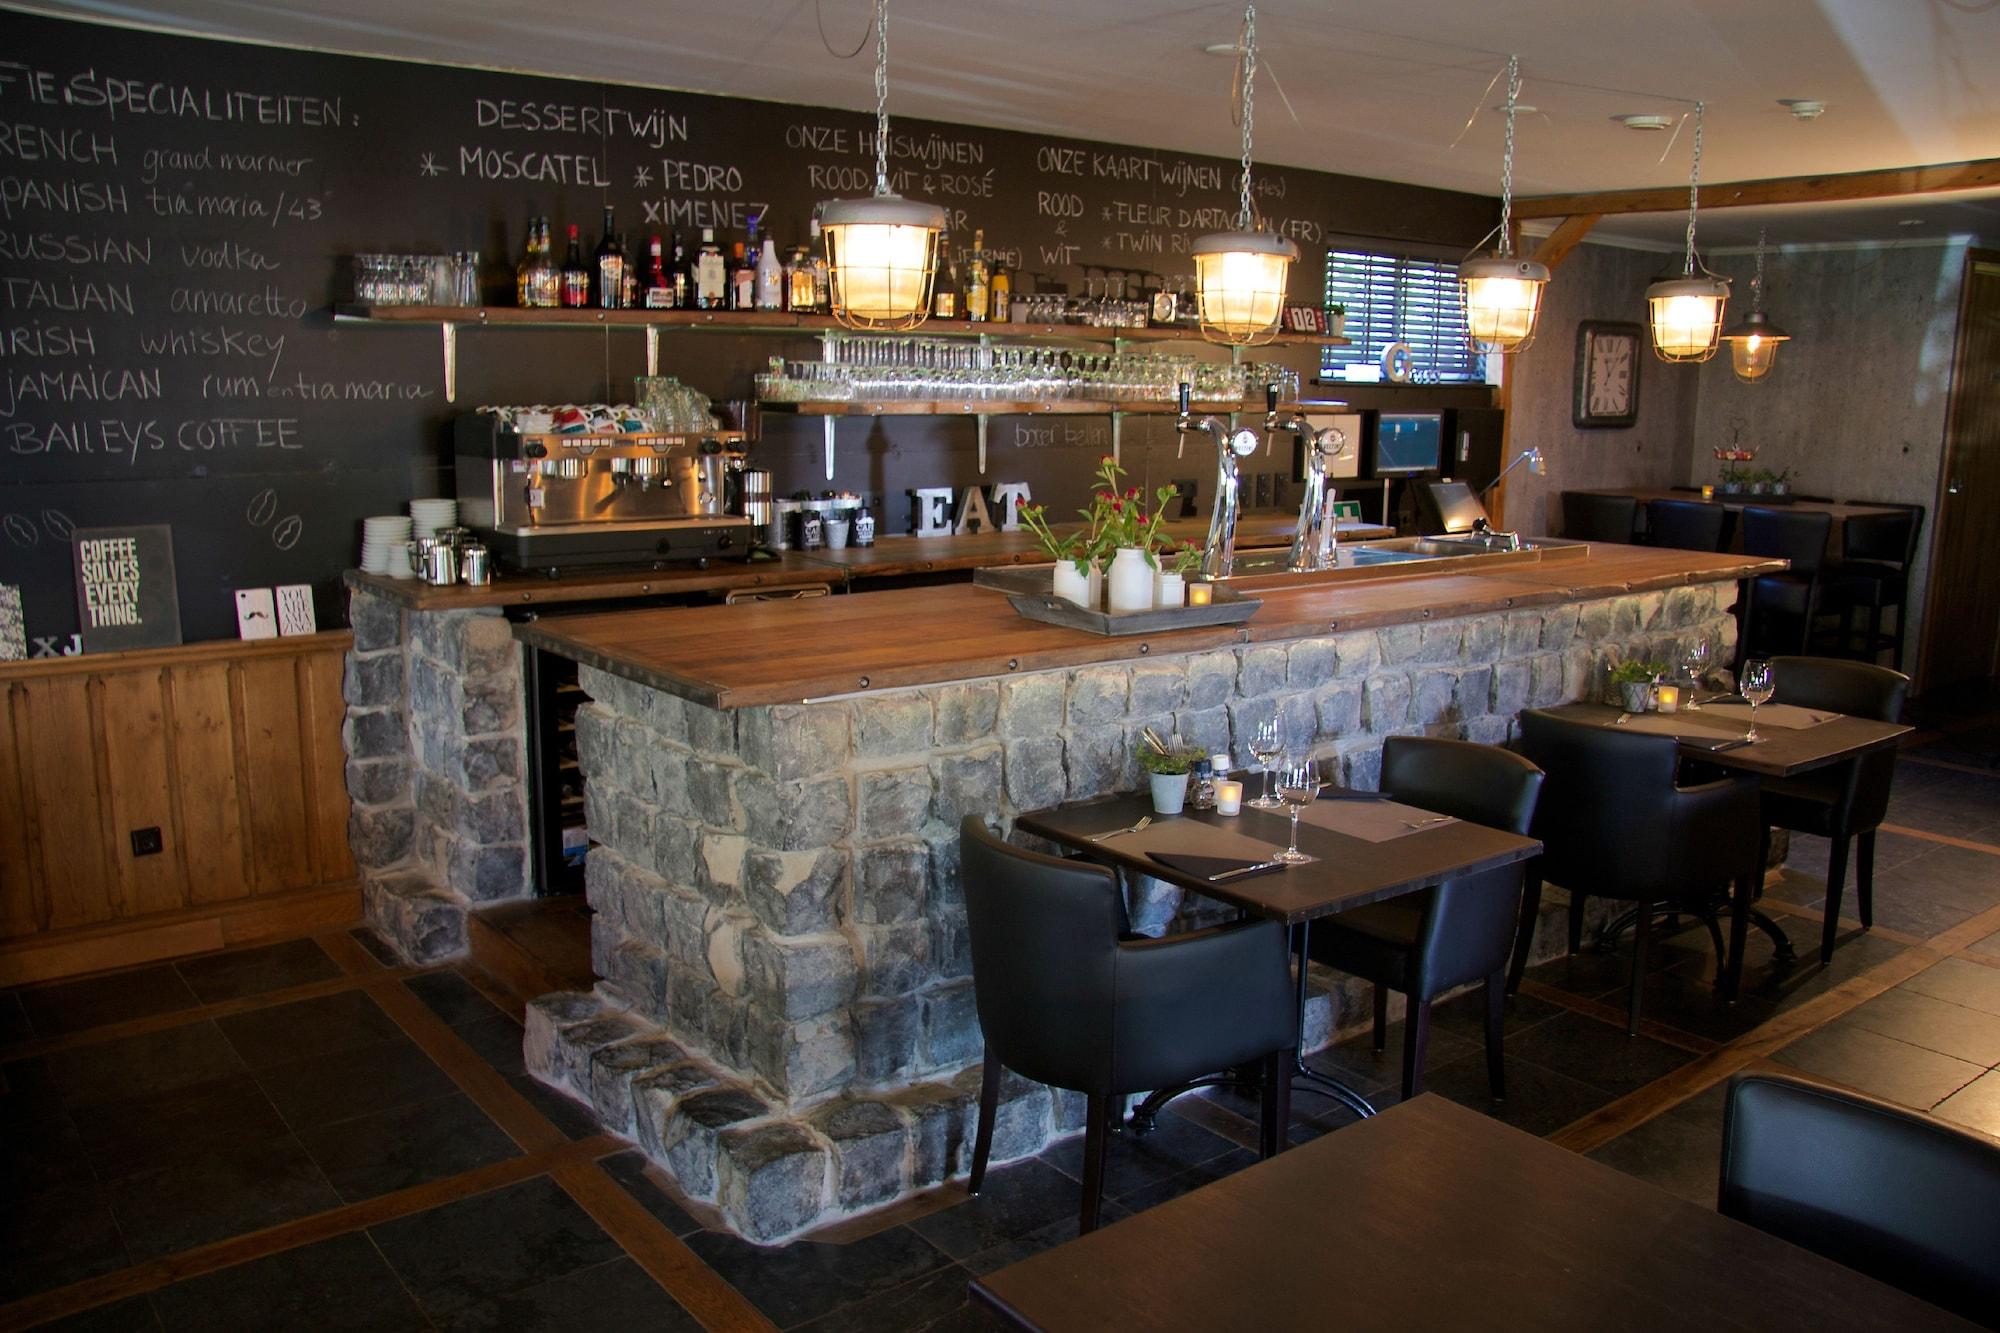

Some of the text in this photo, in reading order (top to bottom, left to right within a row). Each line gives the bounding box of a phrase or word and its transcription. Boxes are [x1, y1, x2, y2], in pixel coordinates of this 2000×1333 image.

[786, 124, 849, 154] ONZE
[141, 146, 213, 184] grand
[459, 145, 743, 192] MOSCATEL PEDRO
[1037, 145, 1087, 177] ONZE
[941, 167, 996, 198] ROSÉ
[145, 191, 195, 217] tia
[1038, 191, 1085, 218] ROOD
[181, 241, 281, 272] vodka
[170, 285, 308, 319] amaretto
[1293, 310, 1315, 328] 12
[140, 325, 286, 382] whiskey
[203, 372, 261, 398] rum
[344, 380, 434, 401] maria
[911, 482, 1031, 538] EAT
[80, 538, 137, 561] COFFEE
[81, 560, 140, 584] SOLVES
[85, 582, 140, 606] EVERY
[281, 589, 306, 600] YOU
[284, 601, 309, 612] ARE
[88, 602, 143, 628] THING.
